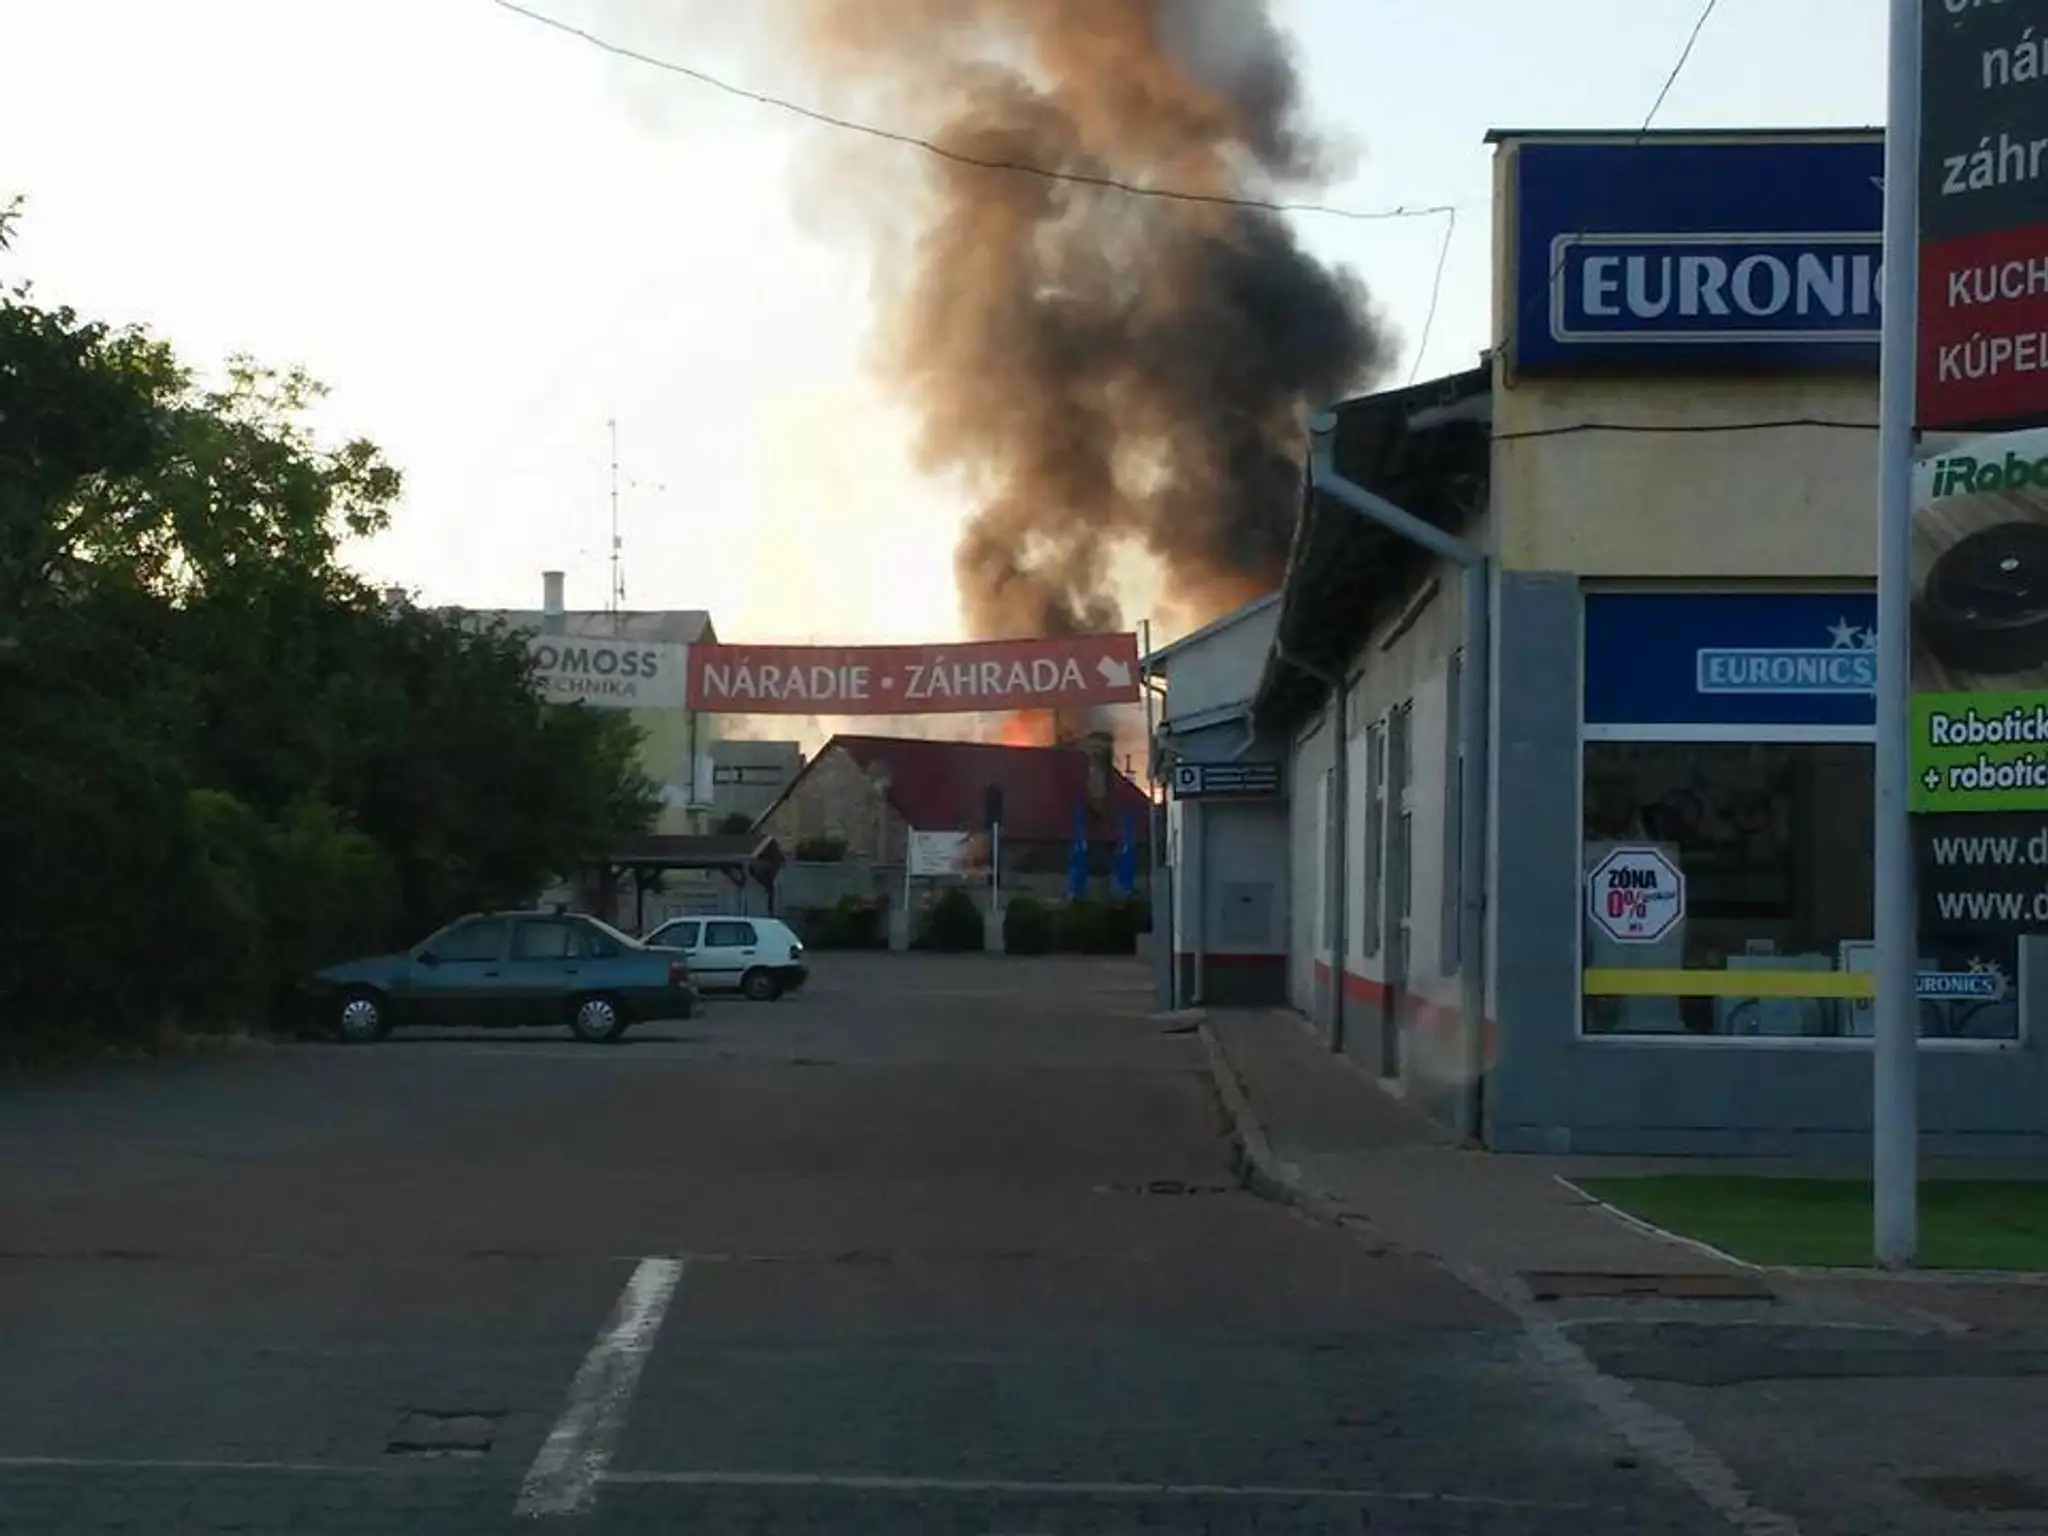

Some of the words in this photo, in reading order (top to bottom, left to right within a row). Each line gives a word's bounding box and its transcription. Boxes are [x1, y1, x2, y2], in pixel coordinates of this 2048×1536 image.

[1942, 133, 2048, 196] záhr
[1582, 253, 1885, 318] EURONI
[1948, 256, 2048, 308] KUCH
[703, 651, 868, 700] NÁRADIE
[904, 645, 1087, 698] ZÁHRADA
[1709, 655, 1873, 684] EURONICS
[1950, 755, 2048, 789] robotic
[1932, 825, 2048, 865] www.d
[1608, 865, 1657, 889] ZÓNA
[1606, 889, 1647, 919] 0%
